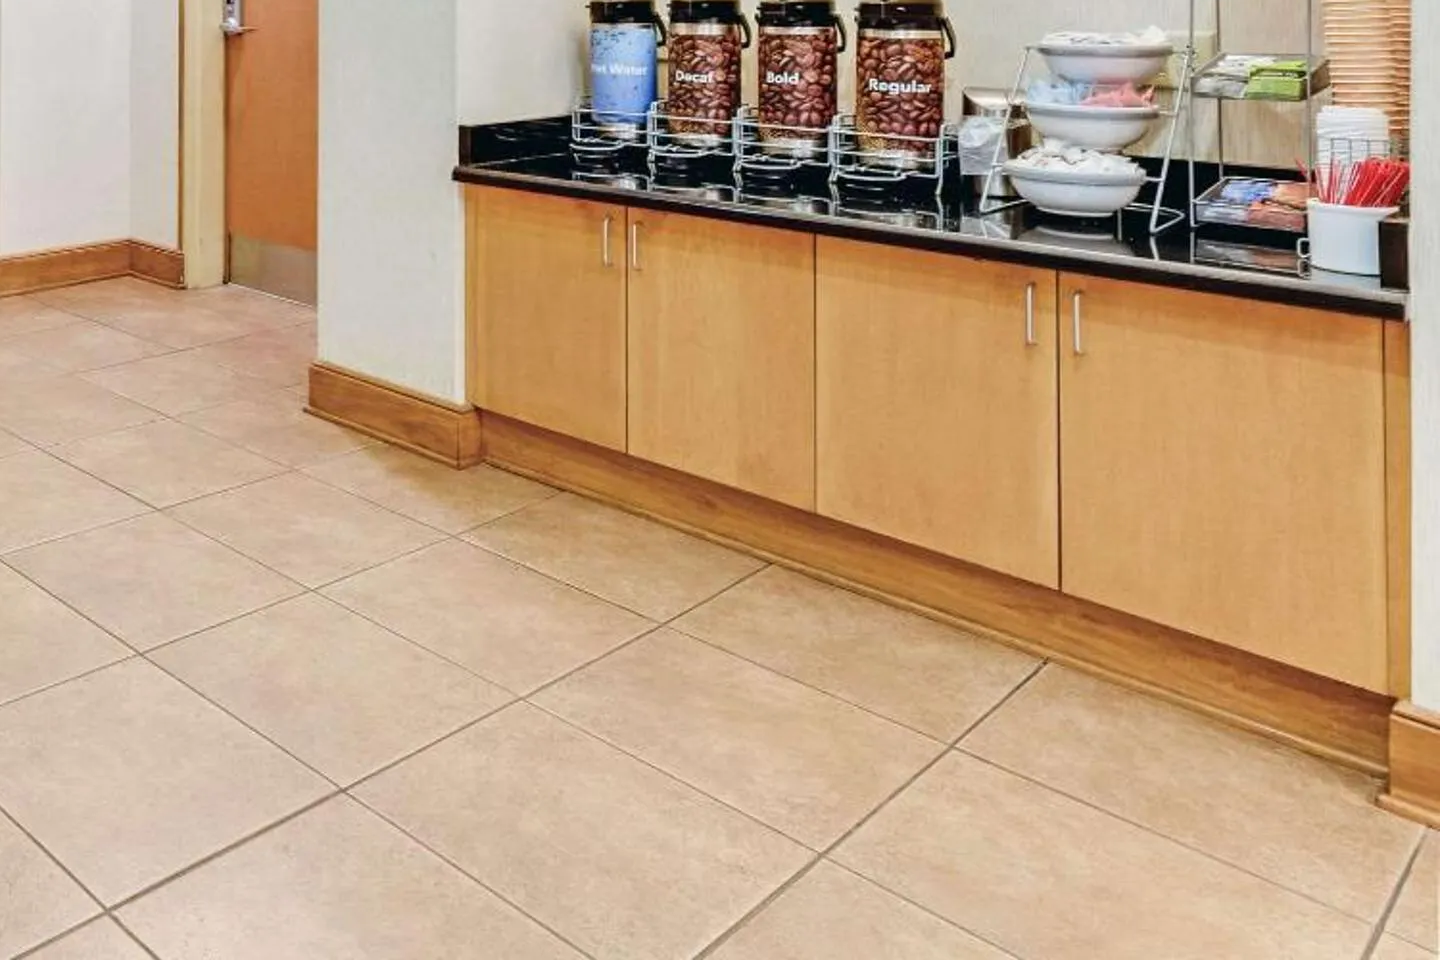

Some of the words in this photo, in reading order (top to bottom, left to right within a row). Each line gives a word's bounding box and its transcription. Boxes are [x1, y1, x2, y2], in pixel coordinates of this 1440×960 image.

[609, 63, 648, 76] Water
[675, 70, 714, 83] Decaf
[766, 71, 799, 85] Bold
[869, 78, 931, 94] Regular
